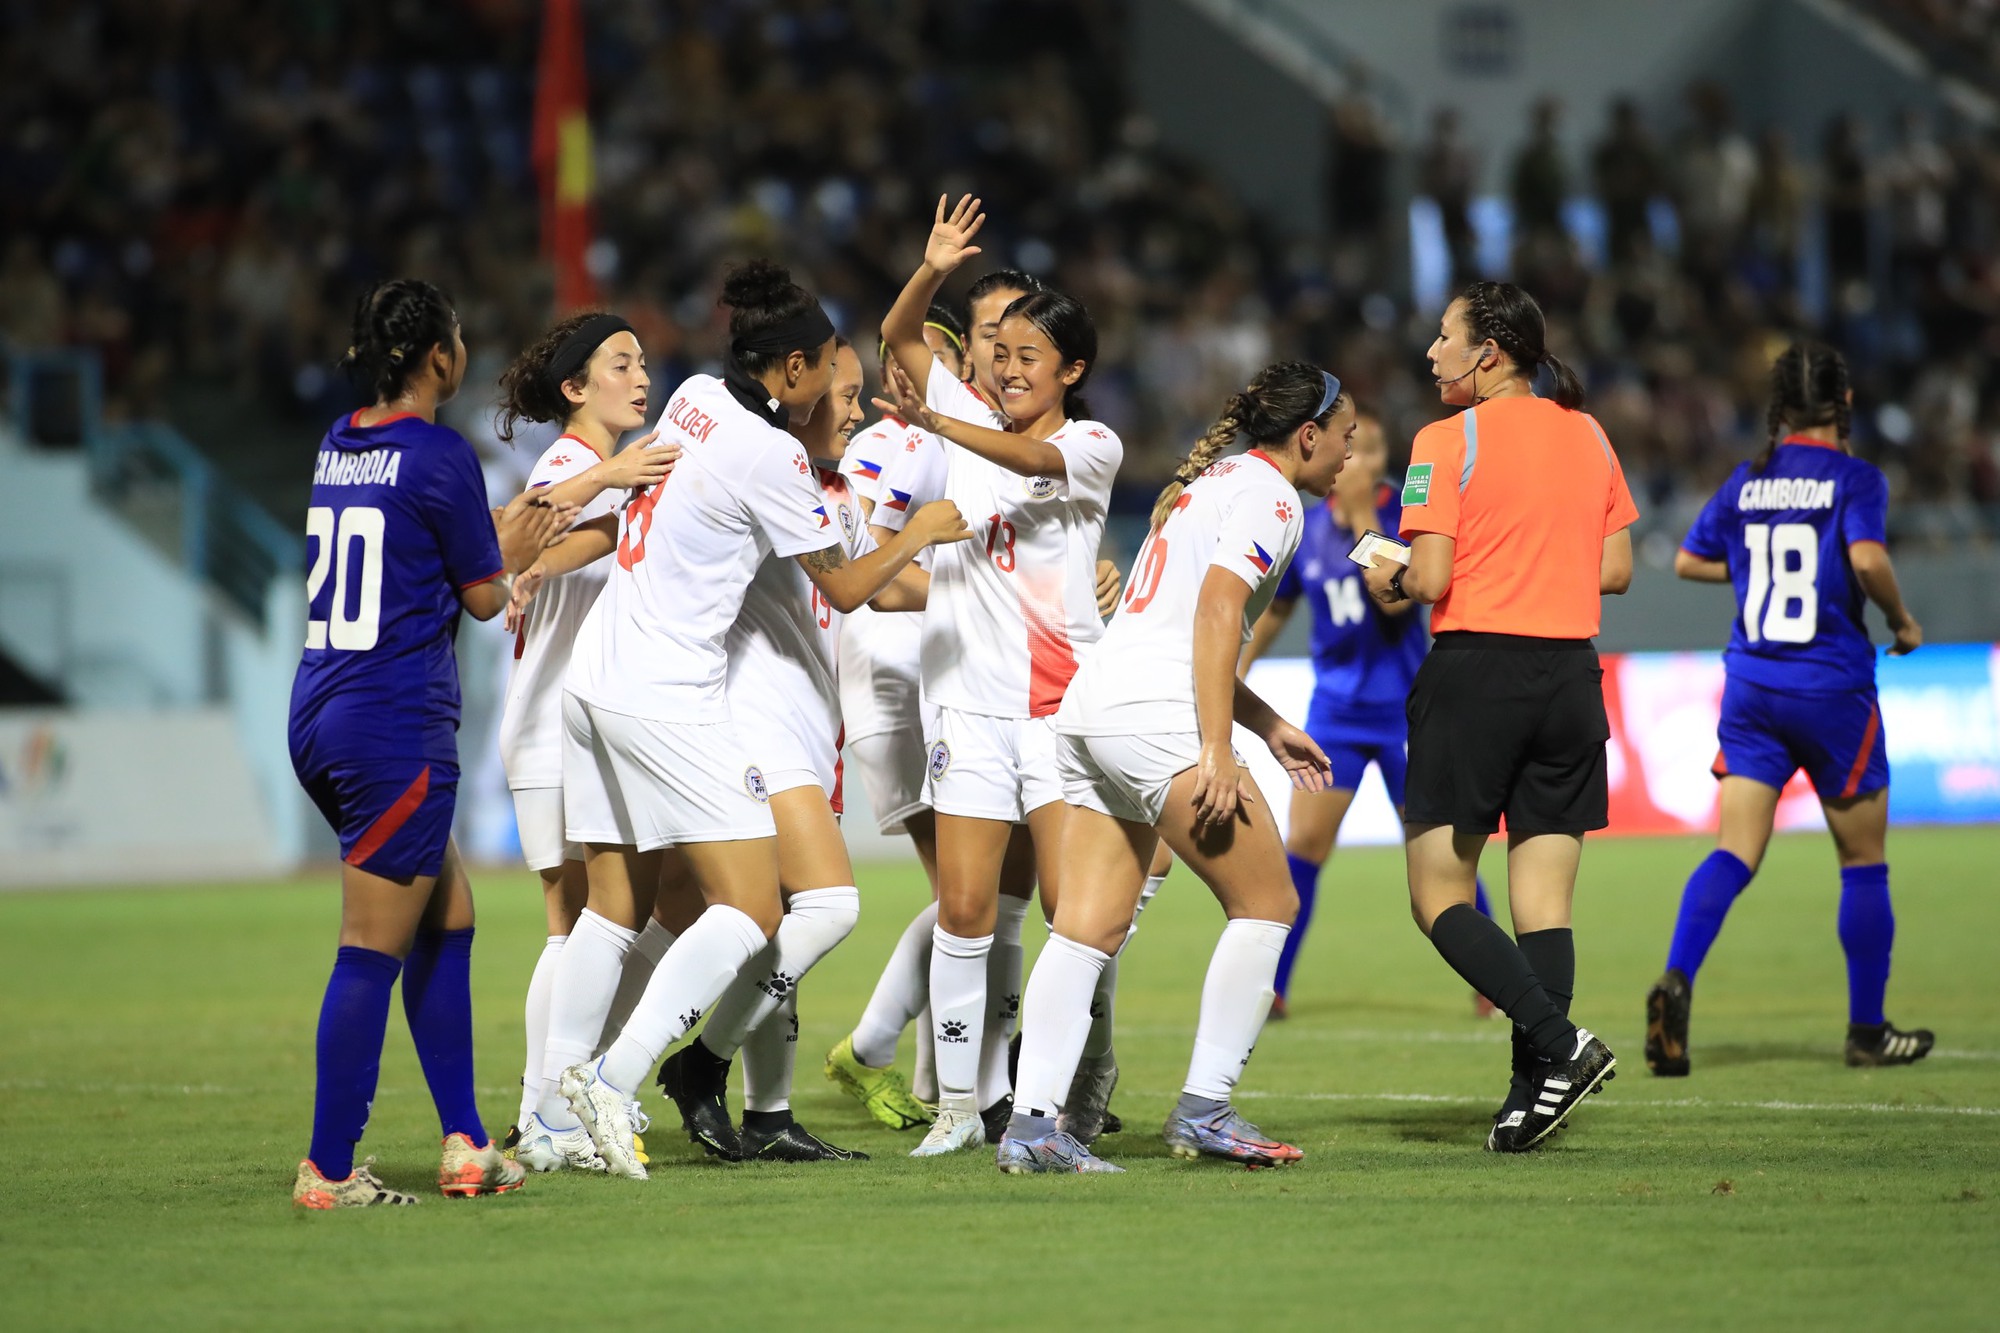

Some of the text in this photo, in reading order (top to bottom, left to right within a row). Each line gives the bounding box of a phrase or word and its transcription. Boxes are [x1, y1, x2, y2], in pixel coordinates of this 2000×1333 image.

[1033, 480, 1052, 488] PFF
[987, 513, 1016, 573] 13
[305, 506, 386, 651] 20
[1324, 576, 1365, 627] 14
[1743, 523, 1818, 643] 18
[937, 1034, 969, 1043] KELME
